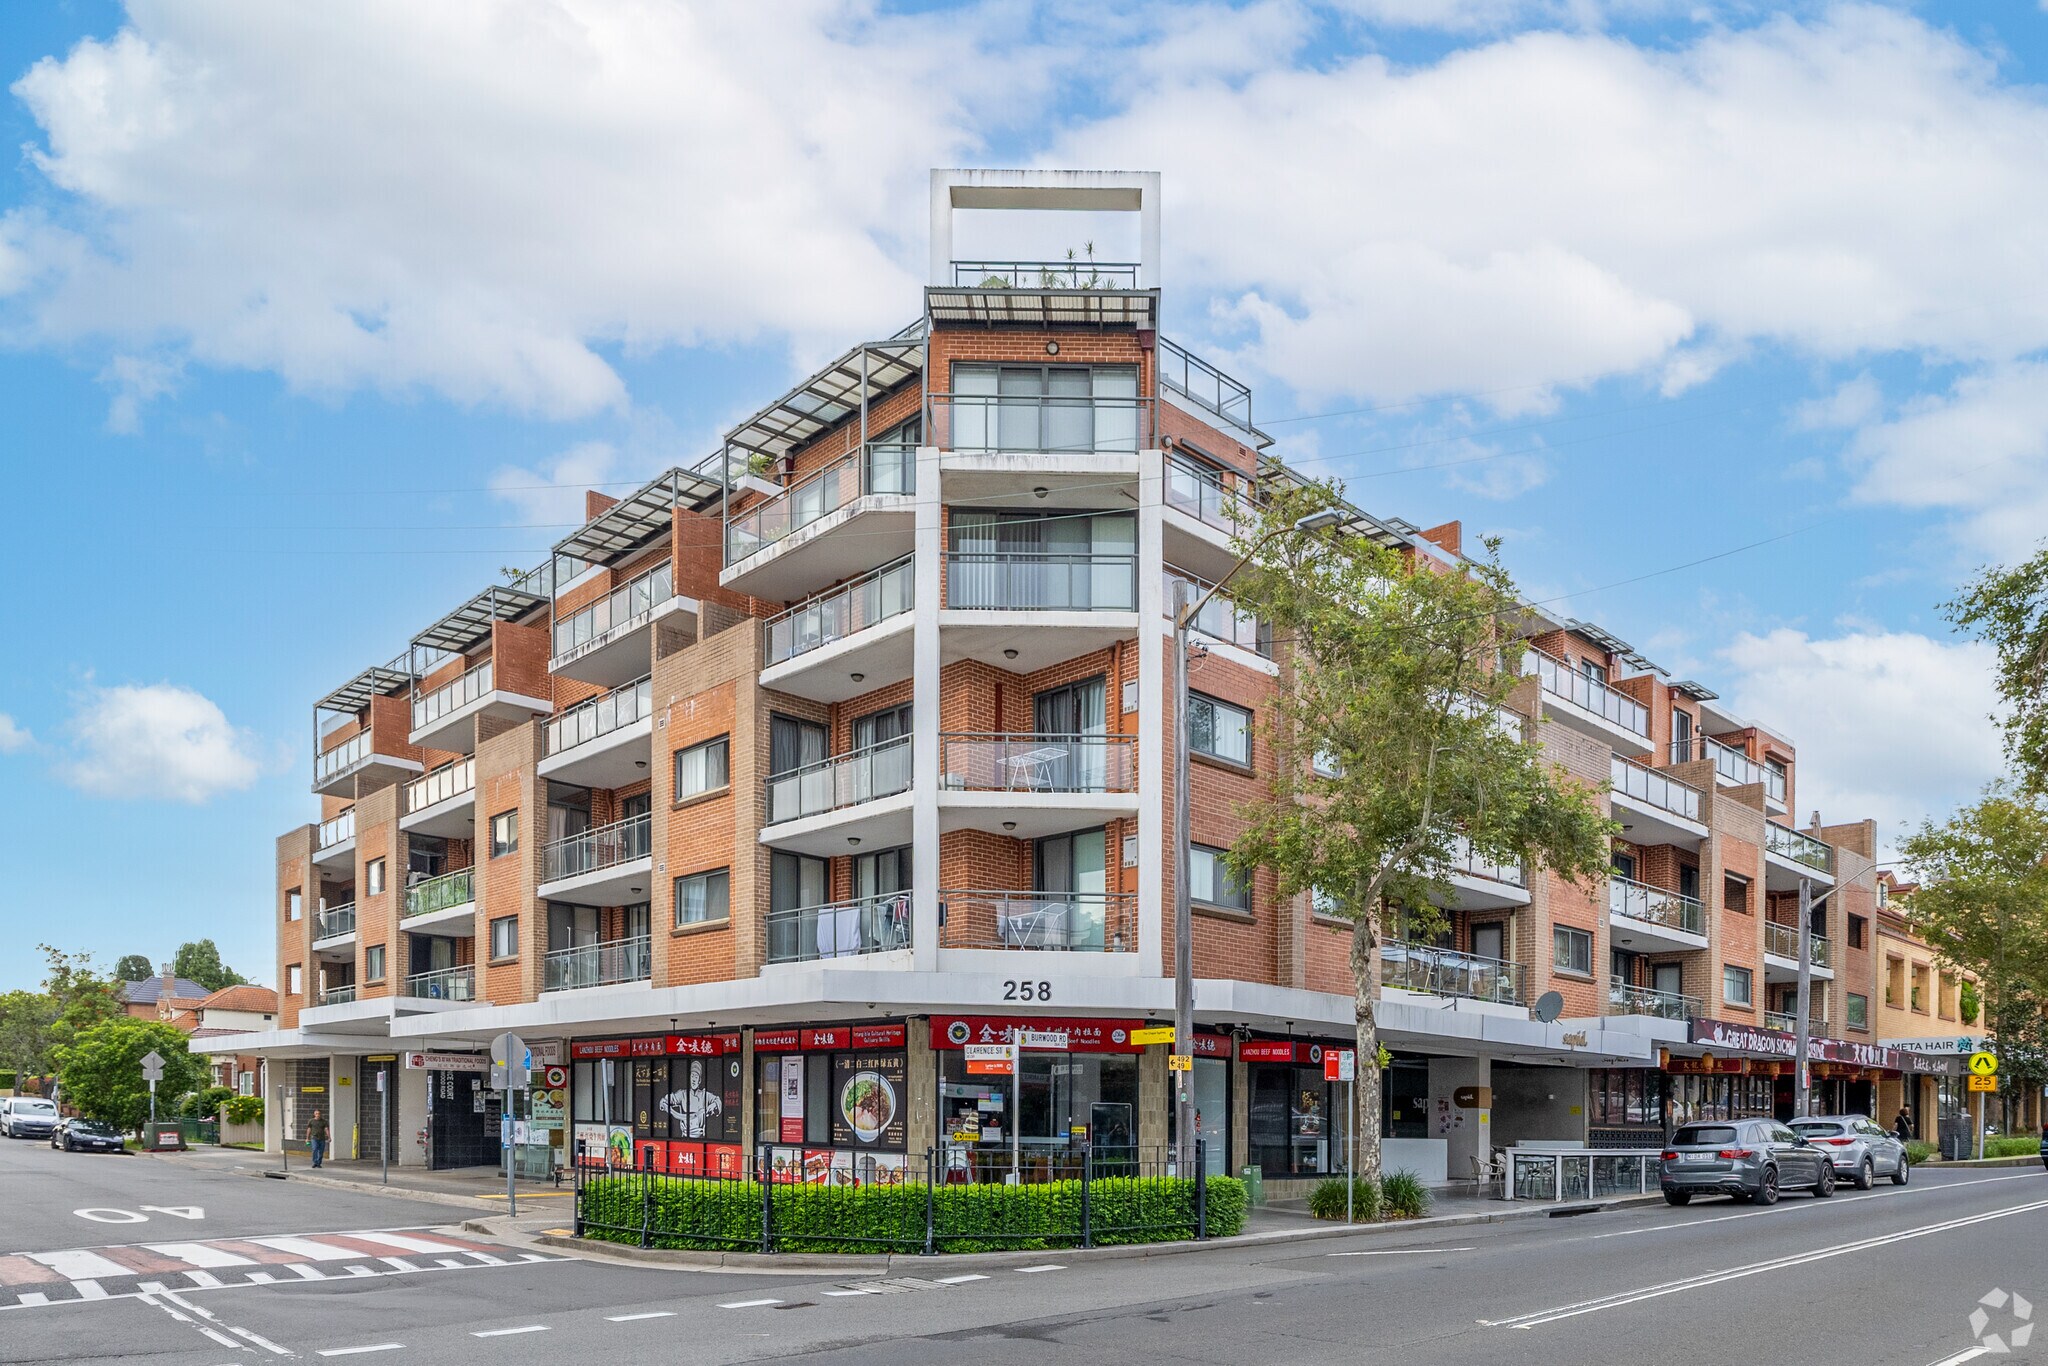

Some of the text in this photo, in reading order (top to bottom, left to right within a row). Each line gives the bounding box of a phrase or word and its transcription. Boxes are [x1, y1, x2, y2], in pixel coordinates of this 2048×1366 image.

[1003, 980, 1051, 1001] 258
[1031, 1034, 1067, 1043] BURWOOD RD
[1726, 1029, 1748, 1048] GREAT
[1749, 1032, 1775, 1053] DRAGON
[579, 1044, 619, 1054] LANZHOU BEEF NOODLES
[966, 1046, 1003, 1054] CLARENCE ST
[1891, 1042, 1921, 1051] META
[1925, 1041, 1953, 1050] HAIR
[1243, 1048, 1290, 1056] LANZHOU BEEF NOODLES
[451, 1056, 474, 1064] TRADITIONAL
[474, 1057, 487, 1065] FOODS
[1974, 1076, 1991, 1085] 25
[73, 1205, 206, 1224] 40
